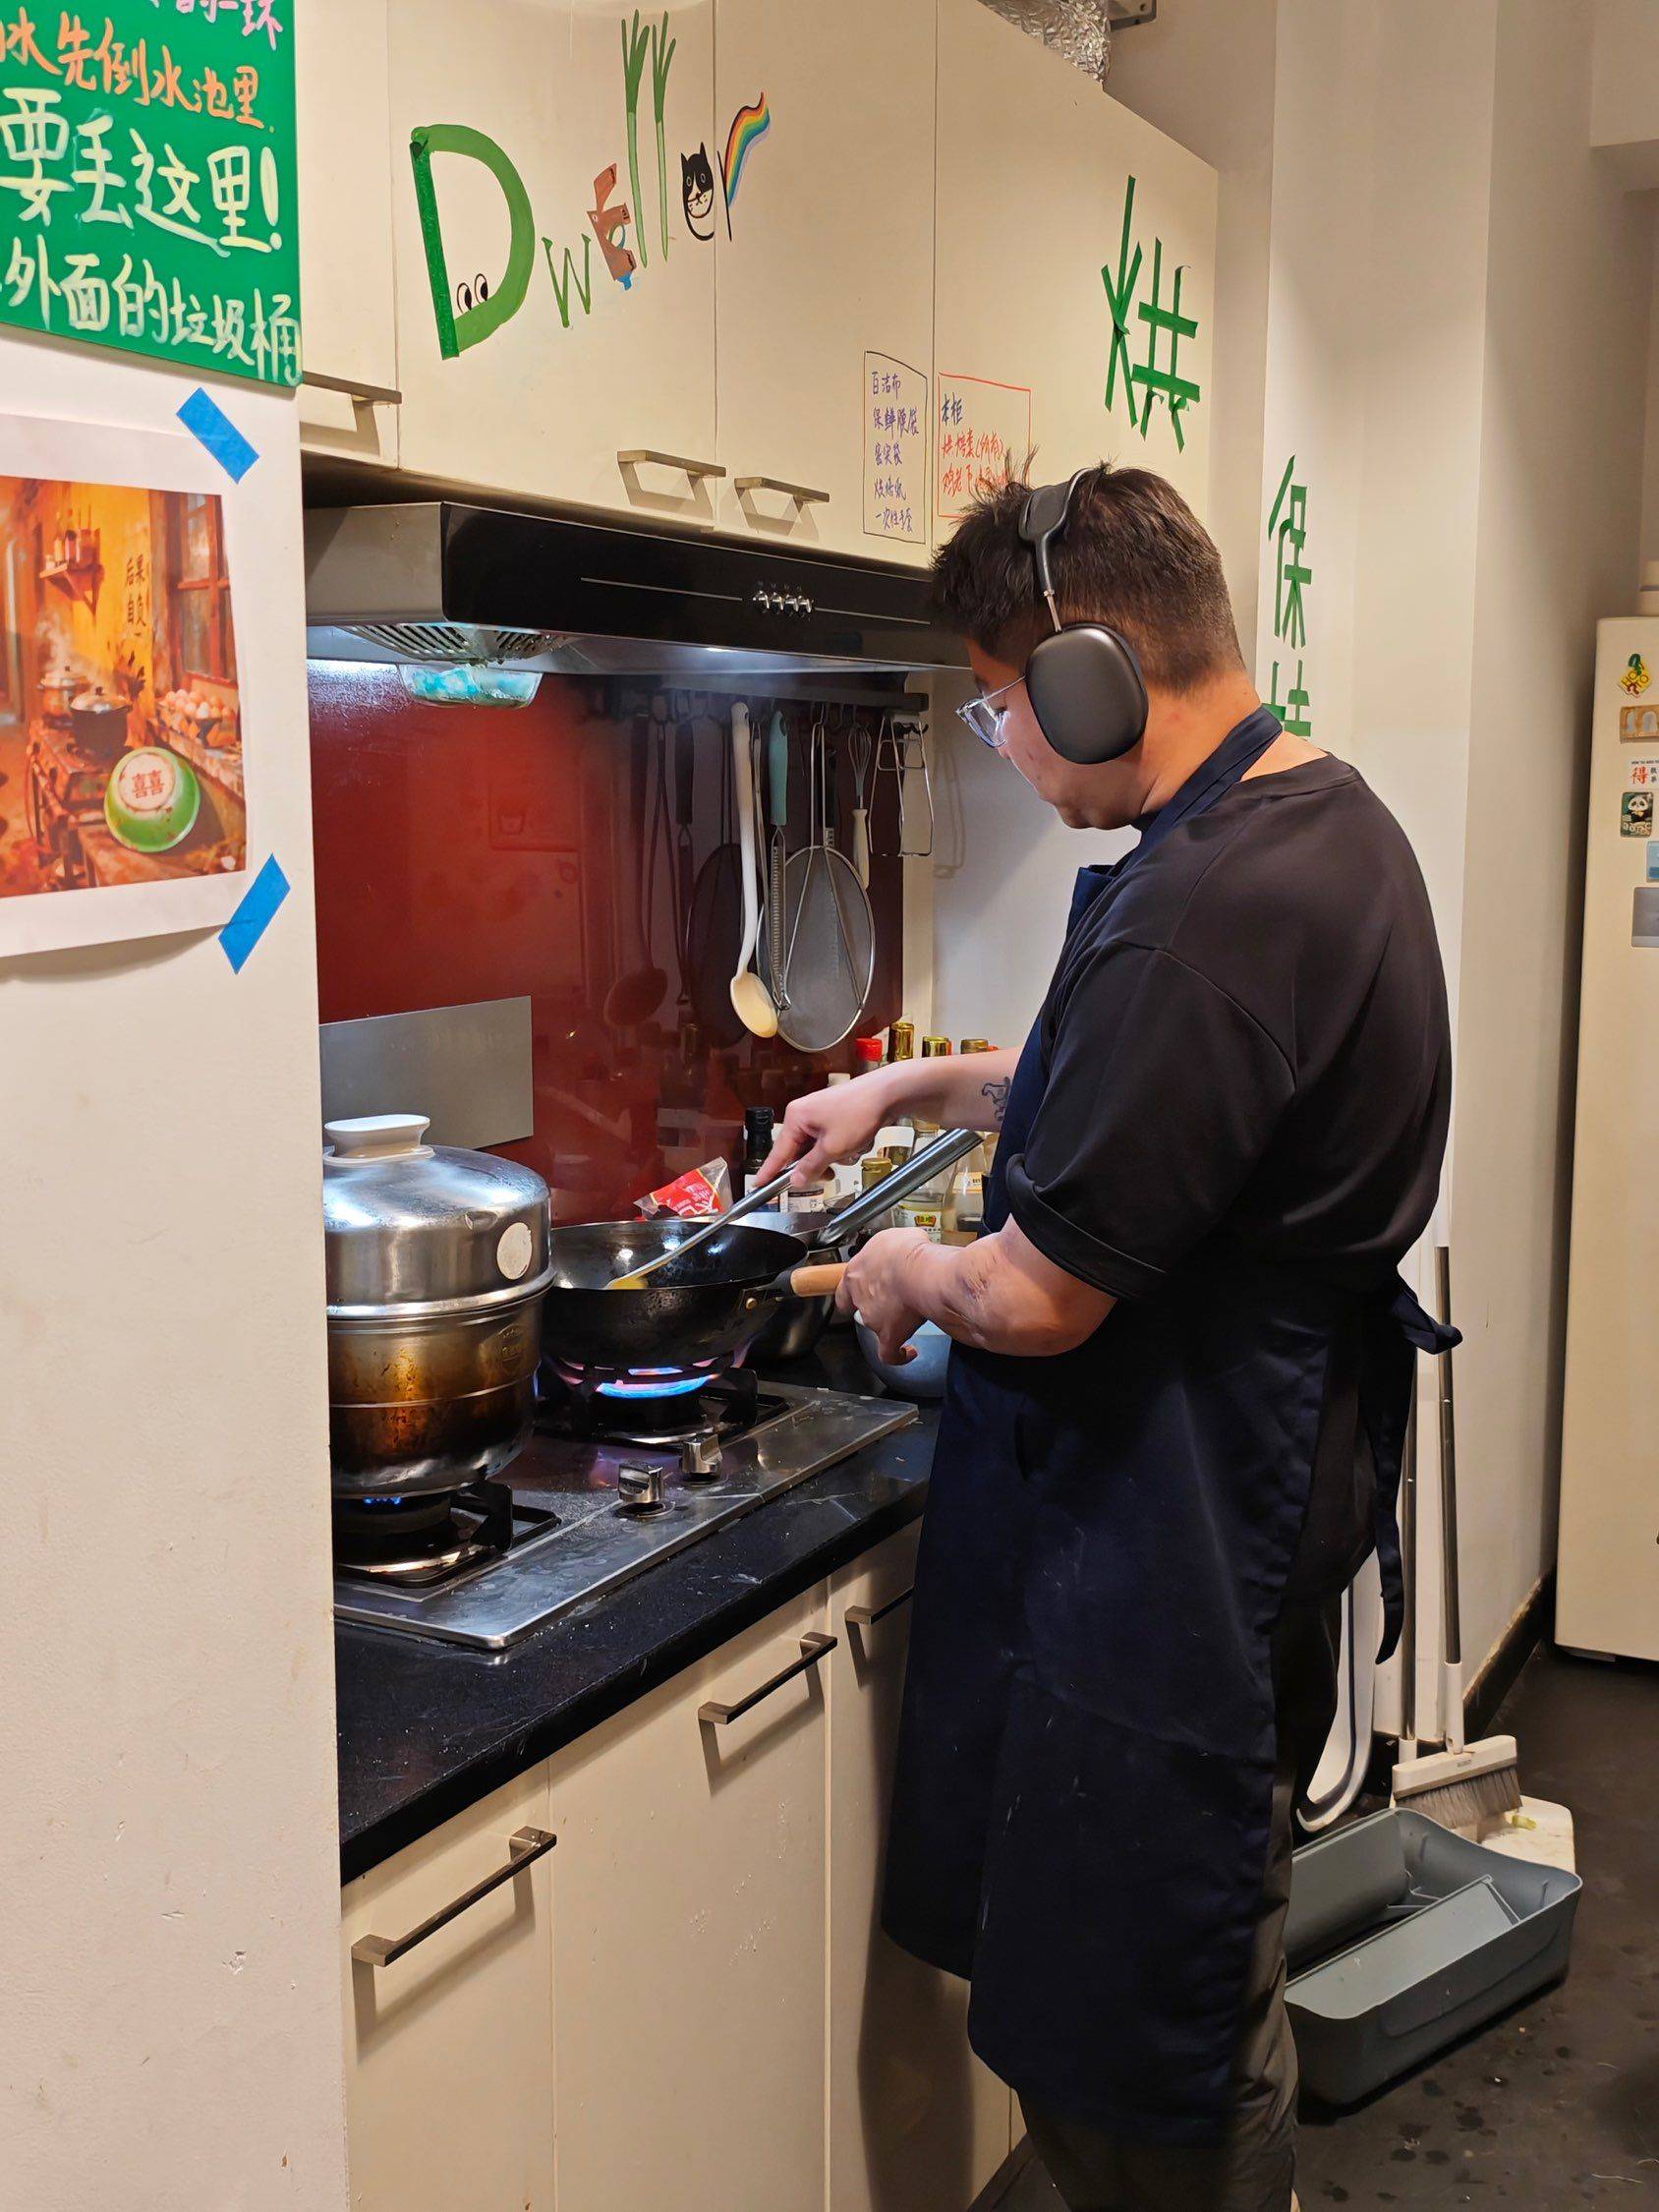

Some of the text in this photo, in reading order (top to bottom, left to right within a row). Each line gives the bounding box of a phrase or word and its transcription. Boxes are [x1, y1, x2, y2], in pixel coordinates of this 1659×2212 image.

[0, 234, 303, 386] 外面的垃圾桶
[875, 506, 913, 532] 一次性手套
